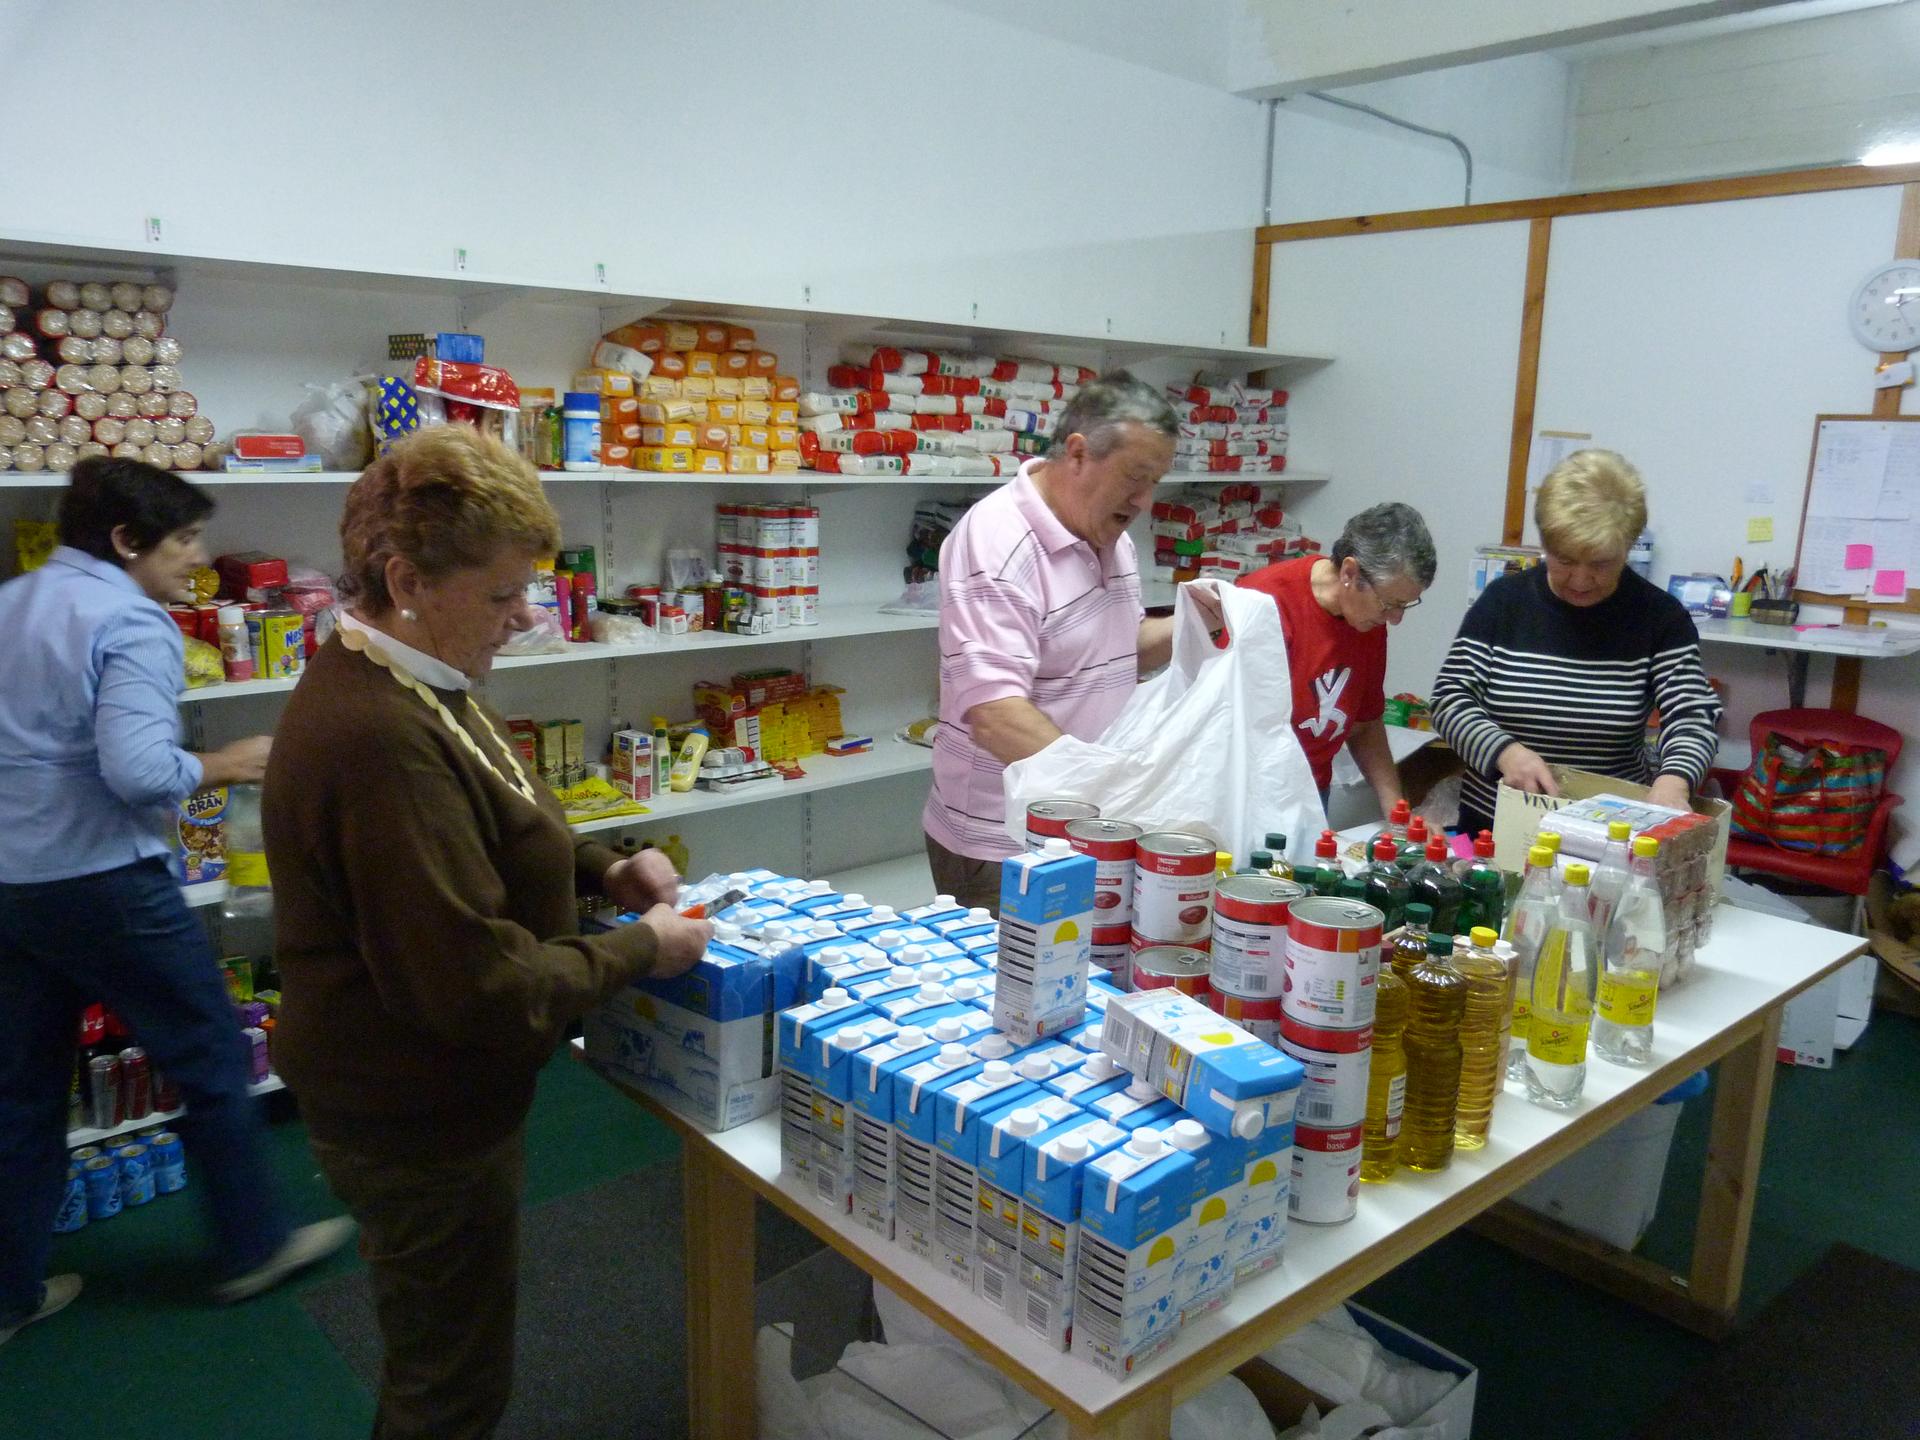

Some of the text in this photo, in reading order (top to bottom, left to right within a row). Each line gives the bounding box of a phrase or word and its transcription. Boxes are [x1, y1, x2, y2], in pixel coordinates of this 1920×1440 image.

[187, 797, 223, 817] BRAN
[1156, 864, 1175, 874] basic
[1326, 1139, 1345, 1150] basic
